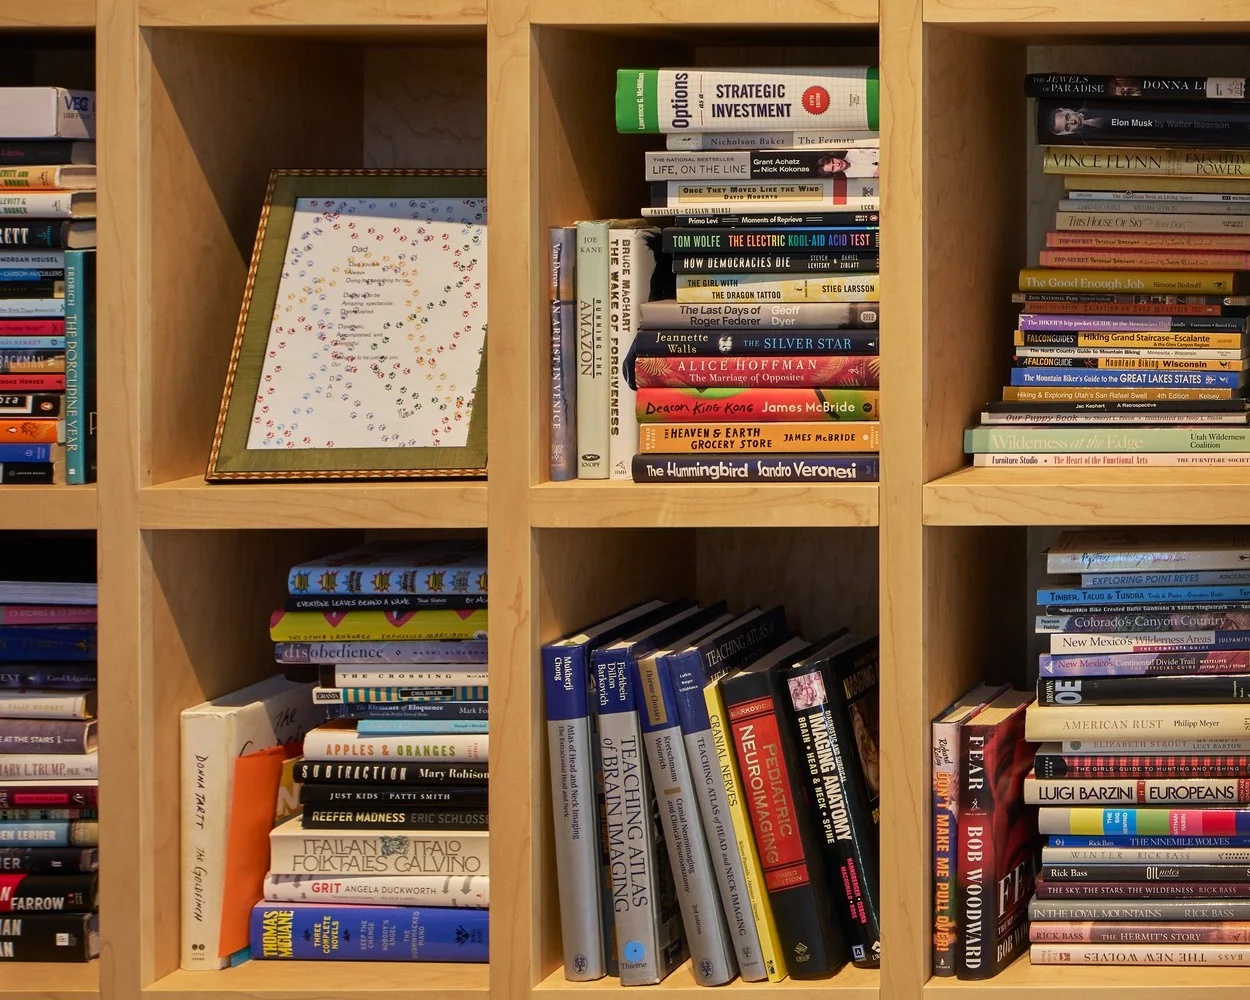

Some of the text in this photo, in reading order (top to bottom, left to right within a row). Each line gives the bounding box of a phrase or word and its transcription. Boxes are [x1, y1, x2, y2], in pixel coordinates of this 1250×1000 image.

[716, 84, 785, 98] STRATEGIC
[671, 72, 689, 129] Options
[711, 103, 791, 118] INVESTMENT
[1111, 118, 1153, 128] Elon Musk
[673, 235, 870, 248] TOM WOLFE THE ELECTRIC KOOL-AID ACID TEST
[351, 245, 369, 253] Dad
[67, 266, 75, 306] ERDRICH
[67, 314, 77, 341] THE
[678, 359, 817, 371] ALICE HOFFMAN
[1120, 373, 1201, 384] GREAT LAKES STATES
[762, 401, 855, 413] James McBride
[67, 419, 78, 452] YEAR
[1190, 433, 1245, 441] Utah Wilderness
[1189, 441, 1220, 449] Coalition
[646, 462, 856, 479] The Hummingbird Sandro Veronesi
[284, 643, 384, 659] disobedience
[1063, 719, 1220, 730] AMERICAN RUST Philipp Meyer
[326, 743, 456, 757] APPLES & ORANGES
[709, 714, 738, 808] CRANIAL NERVES
[808, 712, 852, 841] IMAGING ANATOMY
[739, 724, 778, 864] NEUROIMAGING
[763, 743, 792, 837] PEDIATRIC
[1039, 786, 1234, 800] LUIGI BARZINI EUROPEANS
[312, 812, 405, 823] REEFER MADNESS
[303, 839, 461, 856] ITALIAN ITALO
[293, 855, 480, 872] FOLKTALES CALVINO
[1051, 868, 1088, 877] Rick Bass
[312, 883, 341, 893] GRIT
[11, 897, 64, 910] FARROW
[965, 826, 983, 970] BOB WOODWARD
